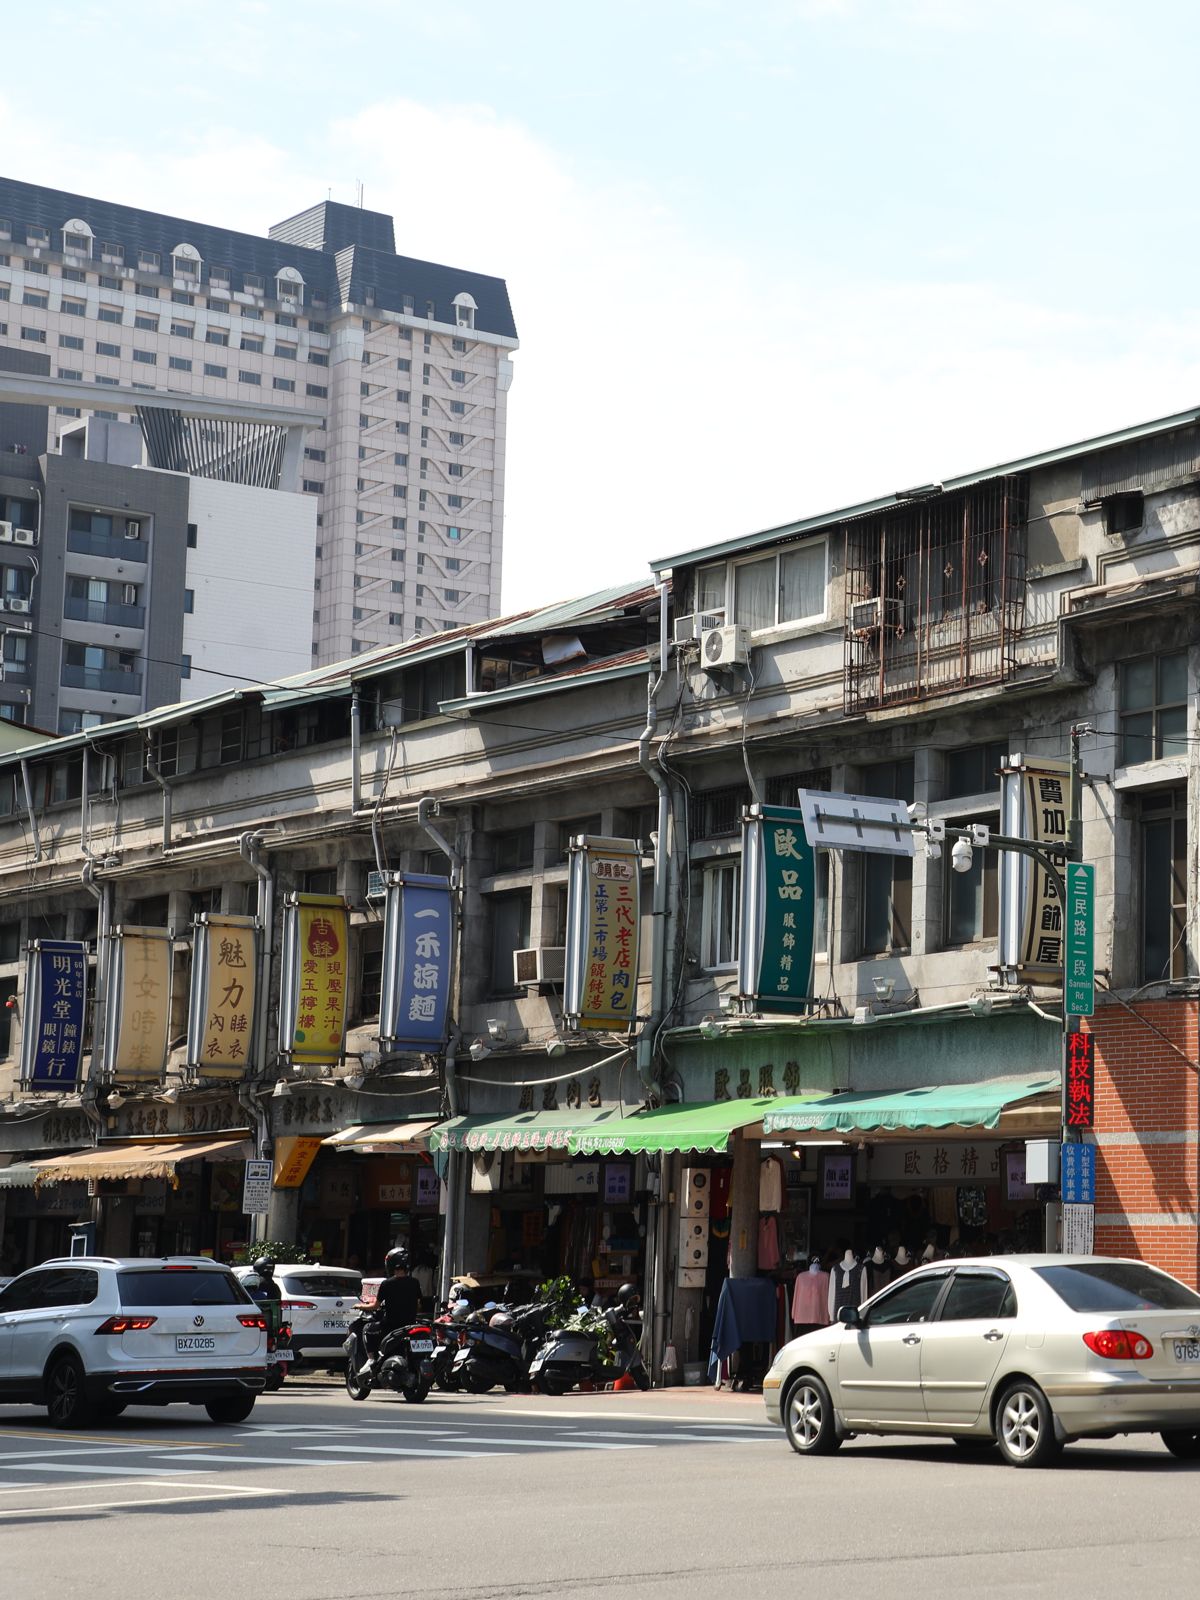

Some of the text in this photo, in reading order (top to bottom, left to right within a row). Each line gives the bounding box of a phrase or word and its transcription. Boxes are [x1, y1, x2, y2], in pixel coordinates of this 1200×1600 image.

[774, 827, 803, 901] 歐品
[610, 886, 635, 1010] 三代老店肉包
[777, 914, 797, 992] 服飾精品
[1073, 881, 1088, 977] 三民路二段
[52, 955, 72, 1019] 明光堂
[217, 937, 247, 1009] 魅力
[298, 960, 319, 1028] 愛玉檸檬
[323, 962, 343, 1029] 現壓果汁
[1069, 979, 1092, 989] Sanmin
[41, 1023, 56, 1054] 眼鏡
[206, 1013, 225, 1059] 內衣
[228, 1014, 248, 1059] 睡衣
[1071, 1002, 1089, 1013] Sec.2
[47, 1058, 66, 1077] 行
[1068, 1033, 1091, 1125] 科技執法
[178, 1338, 215, 1349] BXZ-0285
